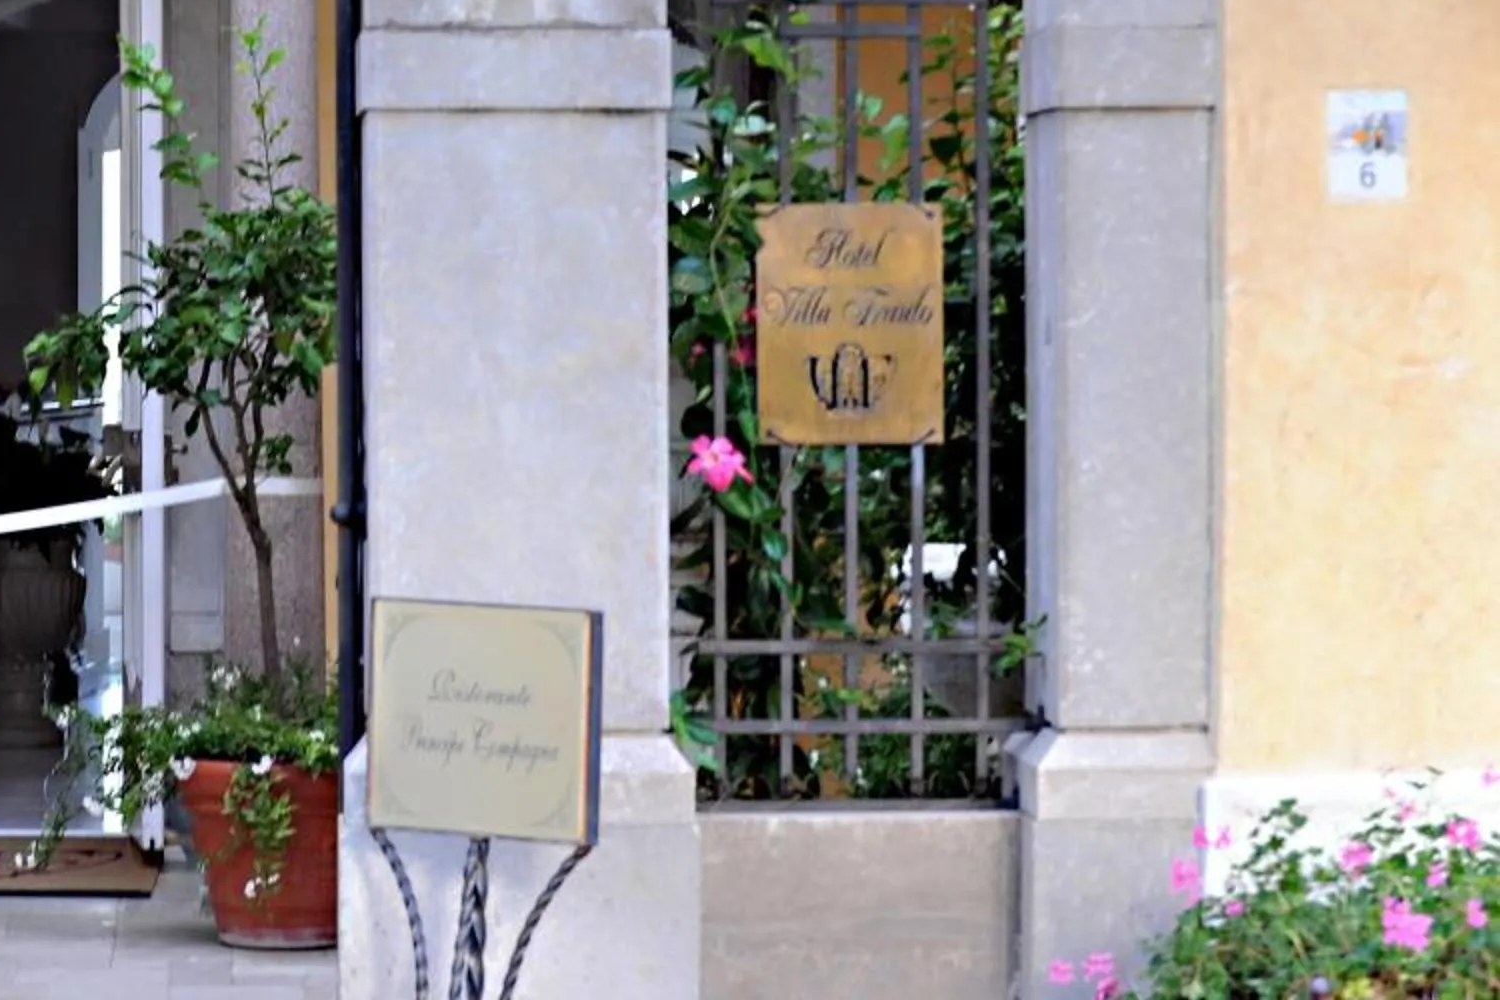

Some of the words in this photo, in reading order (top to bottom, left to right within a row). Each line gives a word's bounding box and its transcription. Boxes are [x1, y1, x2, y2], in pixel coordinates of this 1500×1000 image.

[1359, 161, 1377, 189] 6
[804, 227, 895, 269] Hotel
[763, 285, 832, 327] Villa
